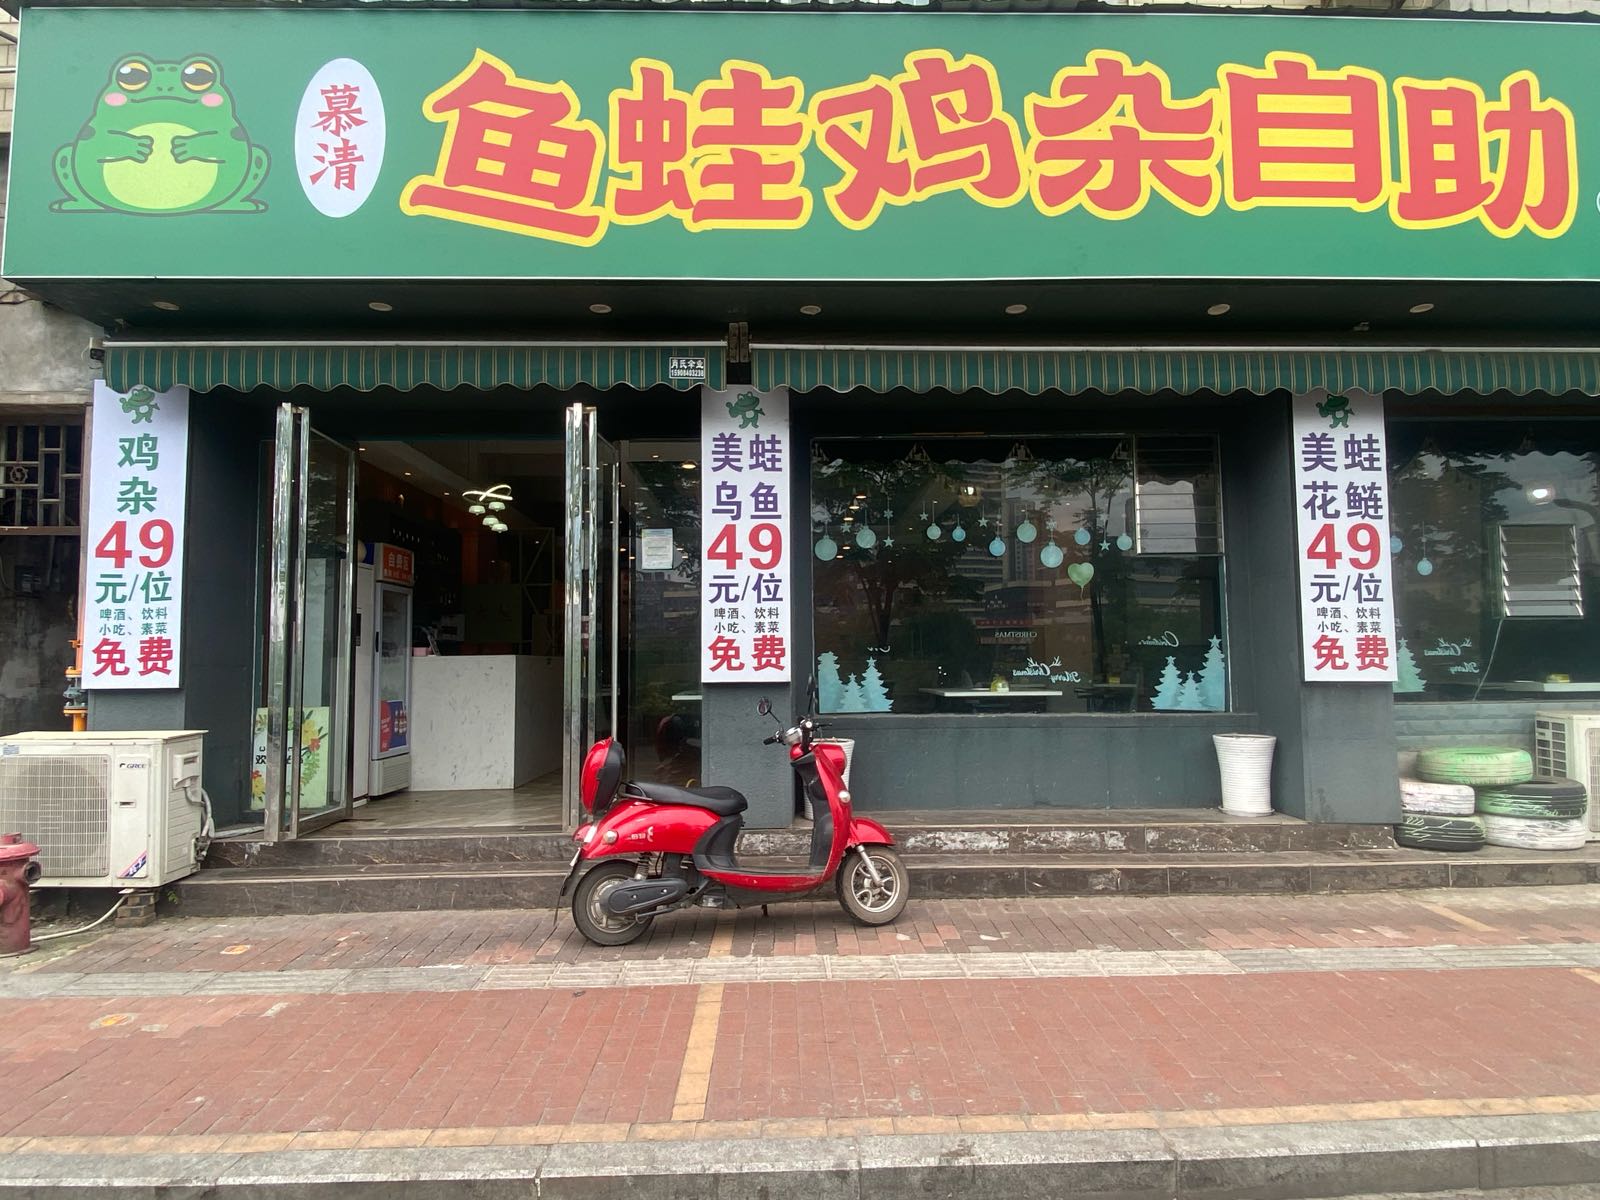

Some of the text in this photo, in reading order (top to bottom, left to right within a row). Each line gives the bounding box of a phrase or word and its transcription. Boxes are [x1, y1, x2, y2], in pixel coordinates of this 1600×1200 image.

[309, 84, 365, 191] 慕清
[400, 48, 1578, 248] 鱼蛙鸡杂自助
[711, 432, 783, 473] 美蛙
[1301, 432, 1382, 473] 美蛙
[117, 432, 160, 516] 鸡杂
[711, 480, 782, 521] 乌鱼
[1302, 480, 1384, 521] 花鲢
[95, 518, 175, 569] 49
[707, 522, 783, 571] 49
[1307, 522, 1381, 571] 49
[94, 570, 173, 605] 元/位
[708, 572, 784, 604] 元/位
[1310, 572, 1384, 604] 元/位
[99, 606, 169, 621] 啤酒、饮料
[99, 622, 168, 636] 小吃、素菜
[713, 606, 780, 620] 啤酒、饮料
[713, 621, 780, 634] 小吃、素菜
[1316, 606, 1381, 620] 啤酒、饮料
[1317, 620, 1382, 634] 小吃、素菜
[91, 636, 174, 677] 免费
[708, 634, 786, 672] 免费
[1312, 634, 1389, 671] 免费
